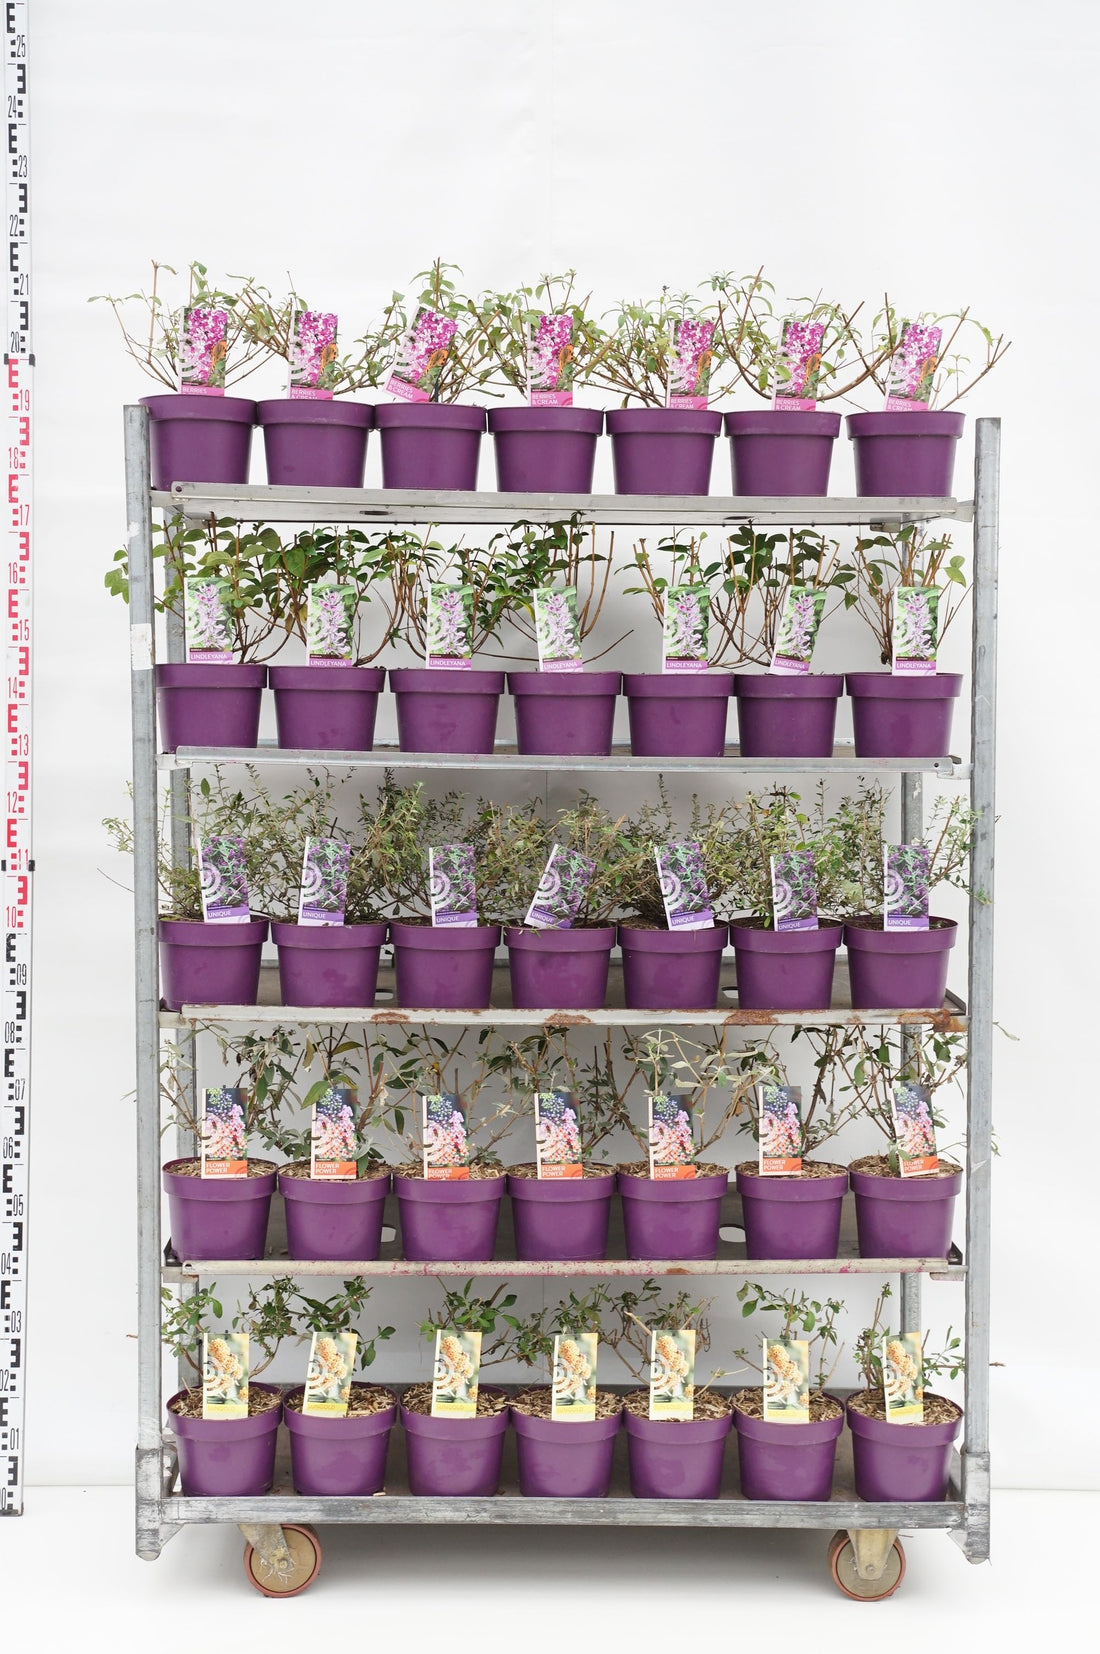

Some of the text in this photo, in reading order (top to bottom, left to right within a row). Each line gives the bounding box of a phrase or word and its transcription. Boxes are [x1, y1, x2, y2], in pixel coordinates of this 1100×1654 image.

[17, 35, 25, 57] 25
[8, 96, 17, 118] 24
[19, 155, 27, 177] 23
[10, 215, 20, 237] 22
[20, 273, 28, 295] 21
[11, 331, 21, 353] 20
[391, 380, 413, 391] BERRIES
[20, 389, 29, 411] 19
[20, 504, 29, 525] 17
[9, 562, 17, 584] 16
[20, 619, 29, 641] 15
[543, 661, 578, 670] LINDLEYANA
[775, 659, 805, 670] LINDLEYANA
[8, 677, 17, 698] 14
[19, 734, 28, 756] 13
[8, 792, 17, 813] 12
[7, 906, 16, 928] 10
[208, 910, 231, 918] UNIQUE
[435, 915, 459, 923] UNIQUE
[531, 912, 555, 923] UNIQUE
[672, 915, 695, 925] UNIQUE
[778, 922, 801, 930] UNIQUE
[17, 964, 27, 985] 09
[5, 1021, 15, 1043] 08
[15, 1078, 25, 1100] 07
[3, 1137, 13, 1159] 06
[13, 1194, 23, 1216] 05
[1, 1253, 11, 1275] 04
[11, 1311, 21, 1333] 03
[10, 1428, 19, 1450] 01
